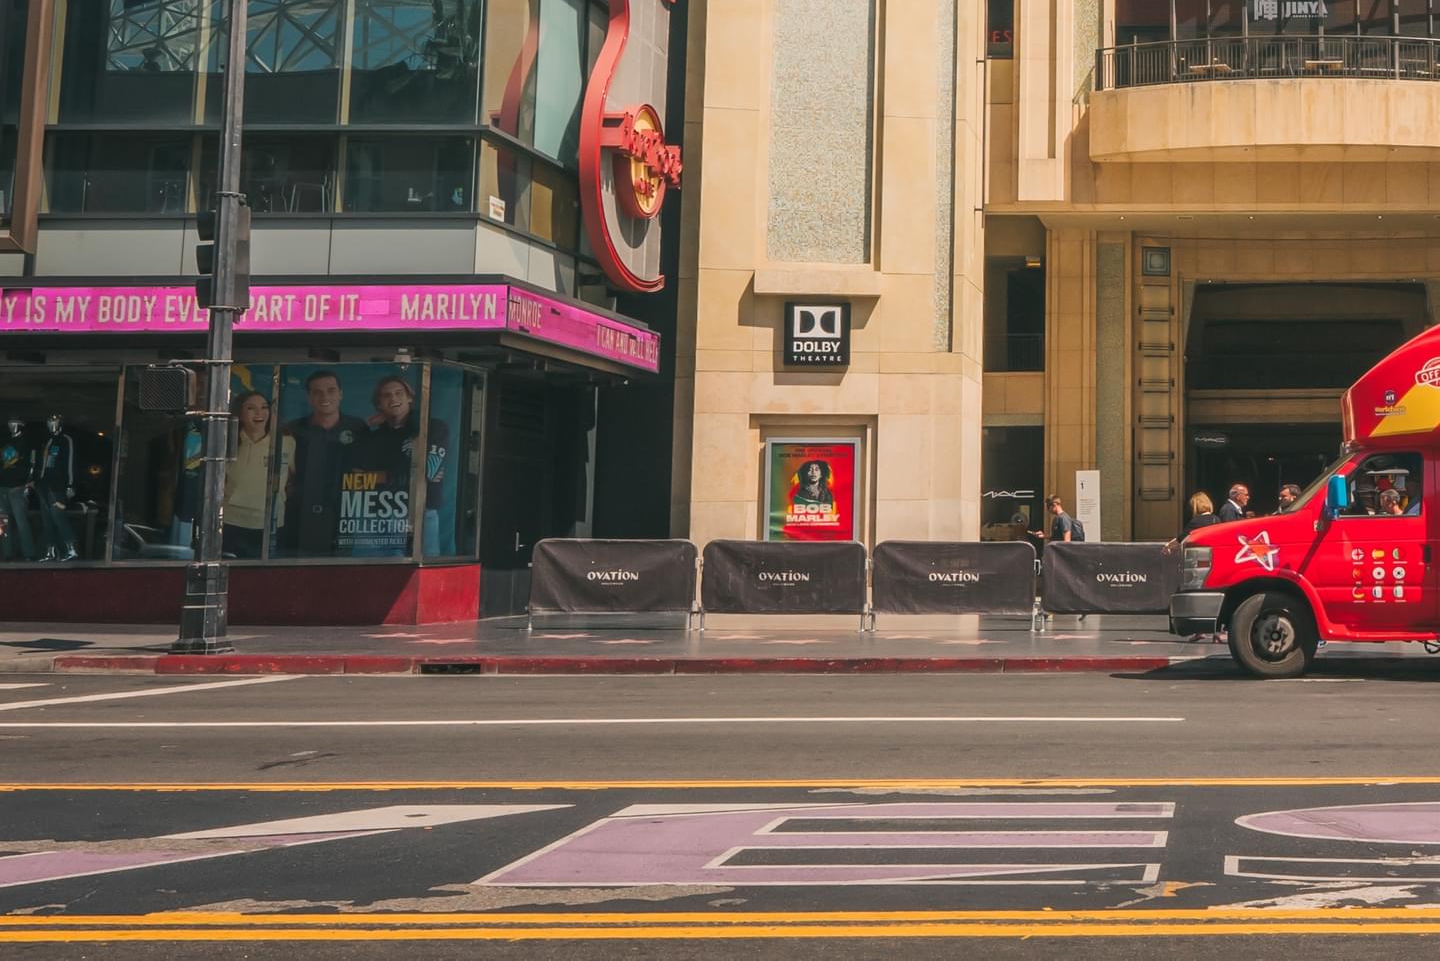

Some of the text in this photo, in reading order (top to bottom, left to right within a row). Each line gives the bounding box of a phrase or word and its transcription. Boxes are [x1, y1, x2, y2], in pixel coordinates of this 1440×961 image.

[0, 296, 18, 323] Y
[25, 296, 46, 323] IS
[56, 296, 91, 323] MY
[99, 295, 157, 323] BODY
[165, 295, 210, 323] EVE
[304, 294, 331, 321] OF
[339, 294, 363, 321] IT.
[400, 293, 497, 321] MARILYN
[509, 293, 542, 328] MONROE
[793, 341, 840, 353] DOLBY
[343, 473, 377, 490] NEW
[341, 491, 408, 518] MESS
[794, 504, 832, 514] BOB
[786, 514, 840, 523] MARLEY
[587, 569, 639, 581] OVATION
[758, 569, 810, 582] OVATION
[928, 570, 980, 582] OVATION
[1096, 570, 1147, 583] OVATION
